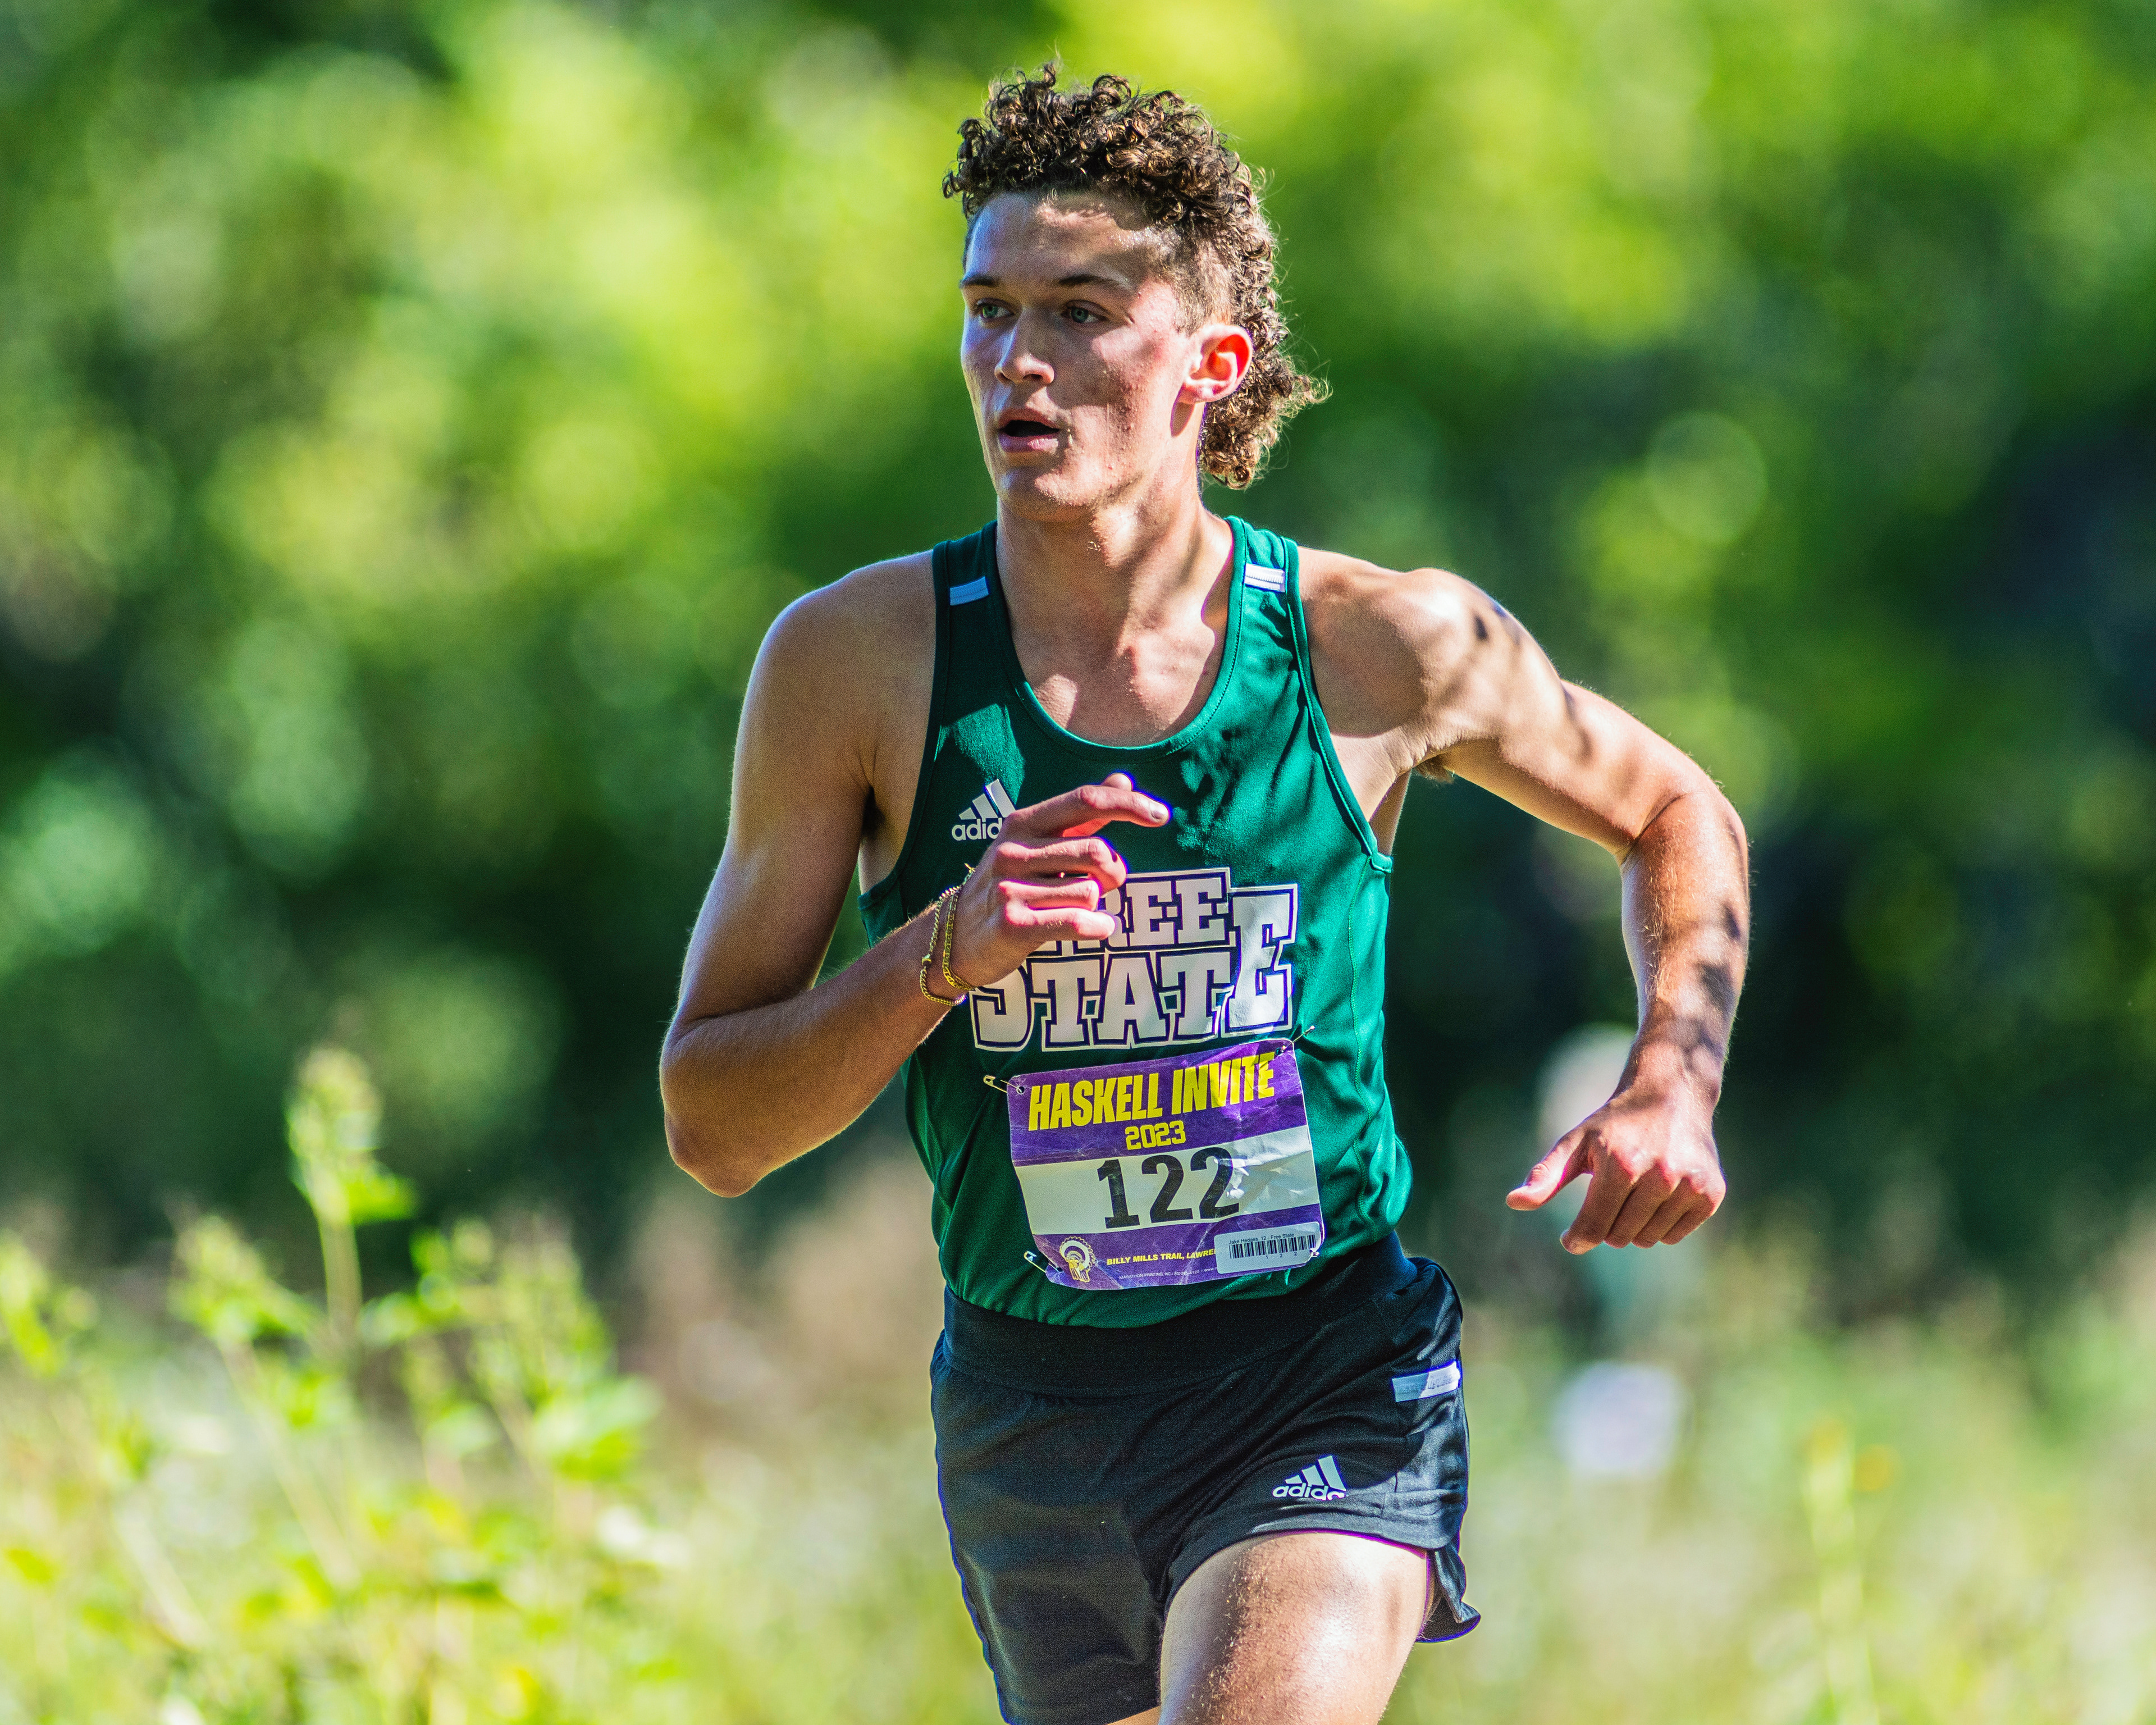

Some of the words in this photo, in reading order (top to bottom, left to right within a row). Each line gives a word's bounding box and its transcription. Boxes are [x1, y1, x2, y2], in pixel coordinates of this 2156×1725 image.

[951, 818, 1002, 841] adid
[970, 883, 1299, 1052] STATE
[1028, 1073, 1163, 1131] HASKELL
[1172, 1052, 1276, 1115] INVITE
[1125, 1120, 1186, 1151] 2023
[1097, 1147, 1239, 1229] 122
[1107, 1257, 1130, 1265] BILLY
[1133, 1254, 1158, 1262] MILLS
